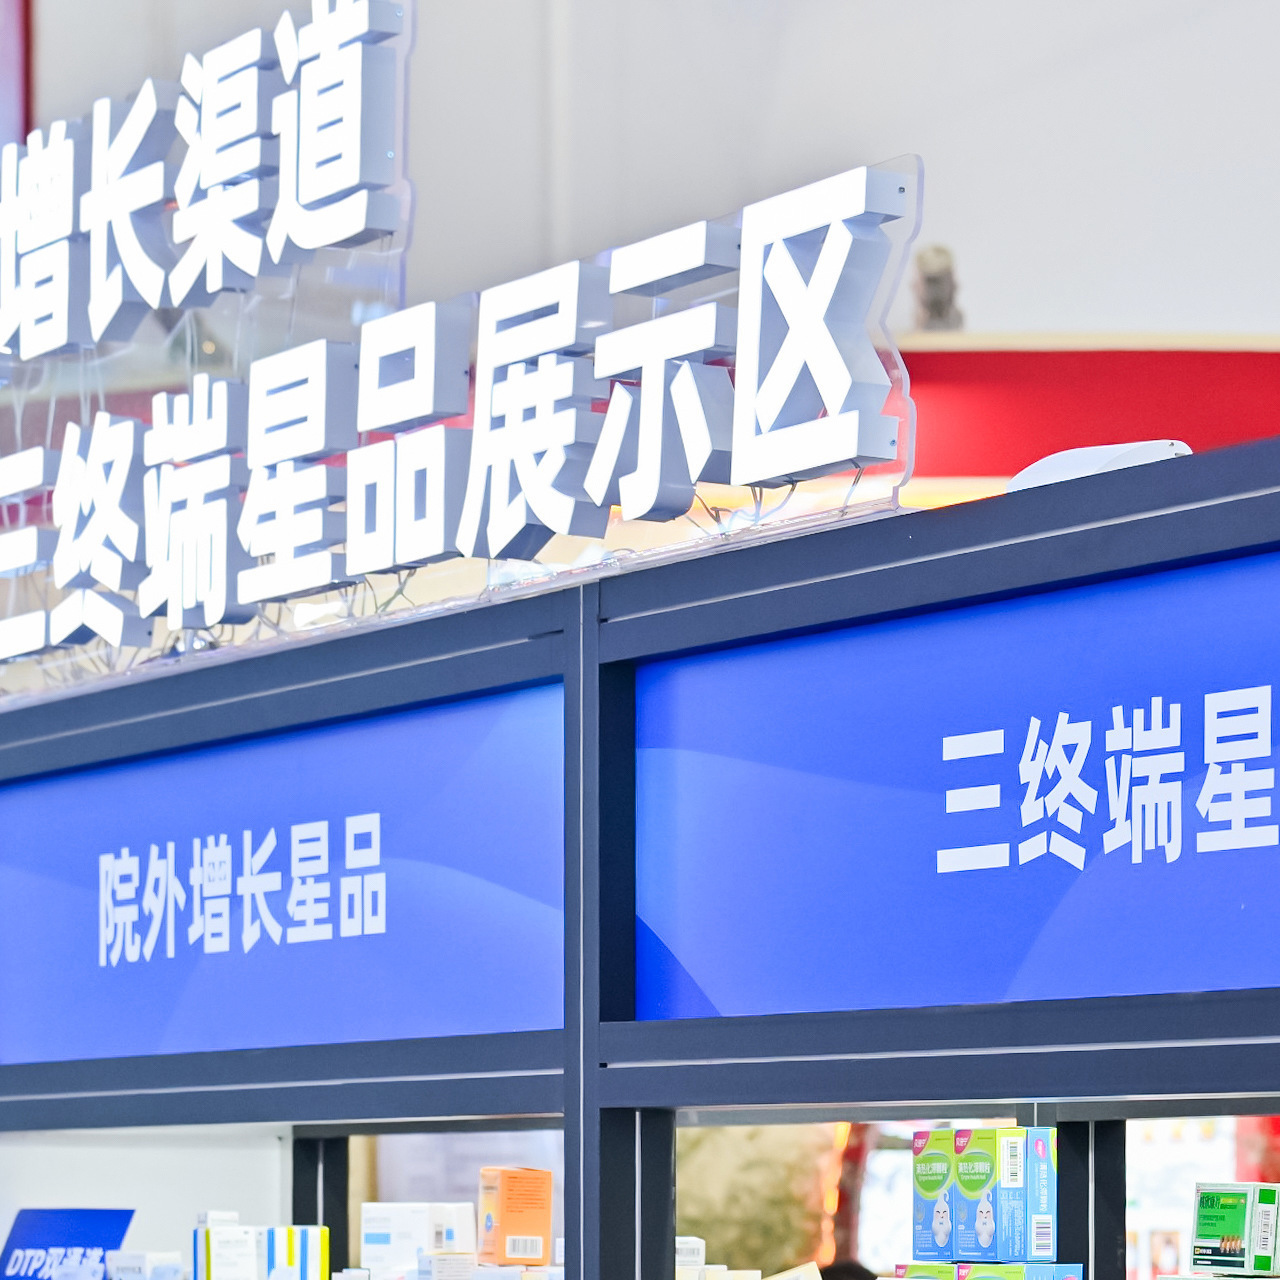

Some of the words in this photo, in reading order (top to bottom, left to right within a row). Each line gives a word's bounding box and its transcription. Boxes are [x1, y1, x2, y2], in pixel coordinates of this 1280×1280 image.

[99, 812, 386, 967] 院外增长星品
